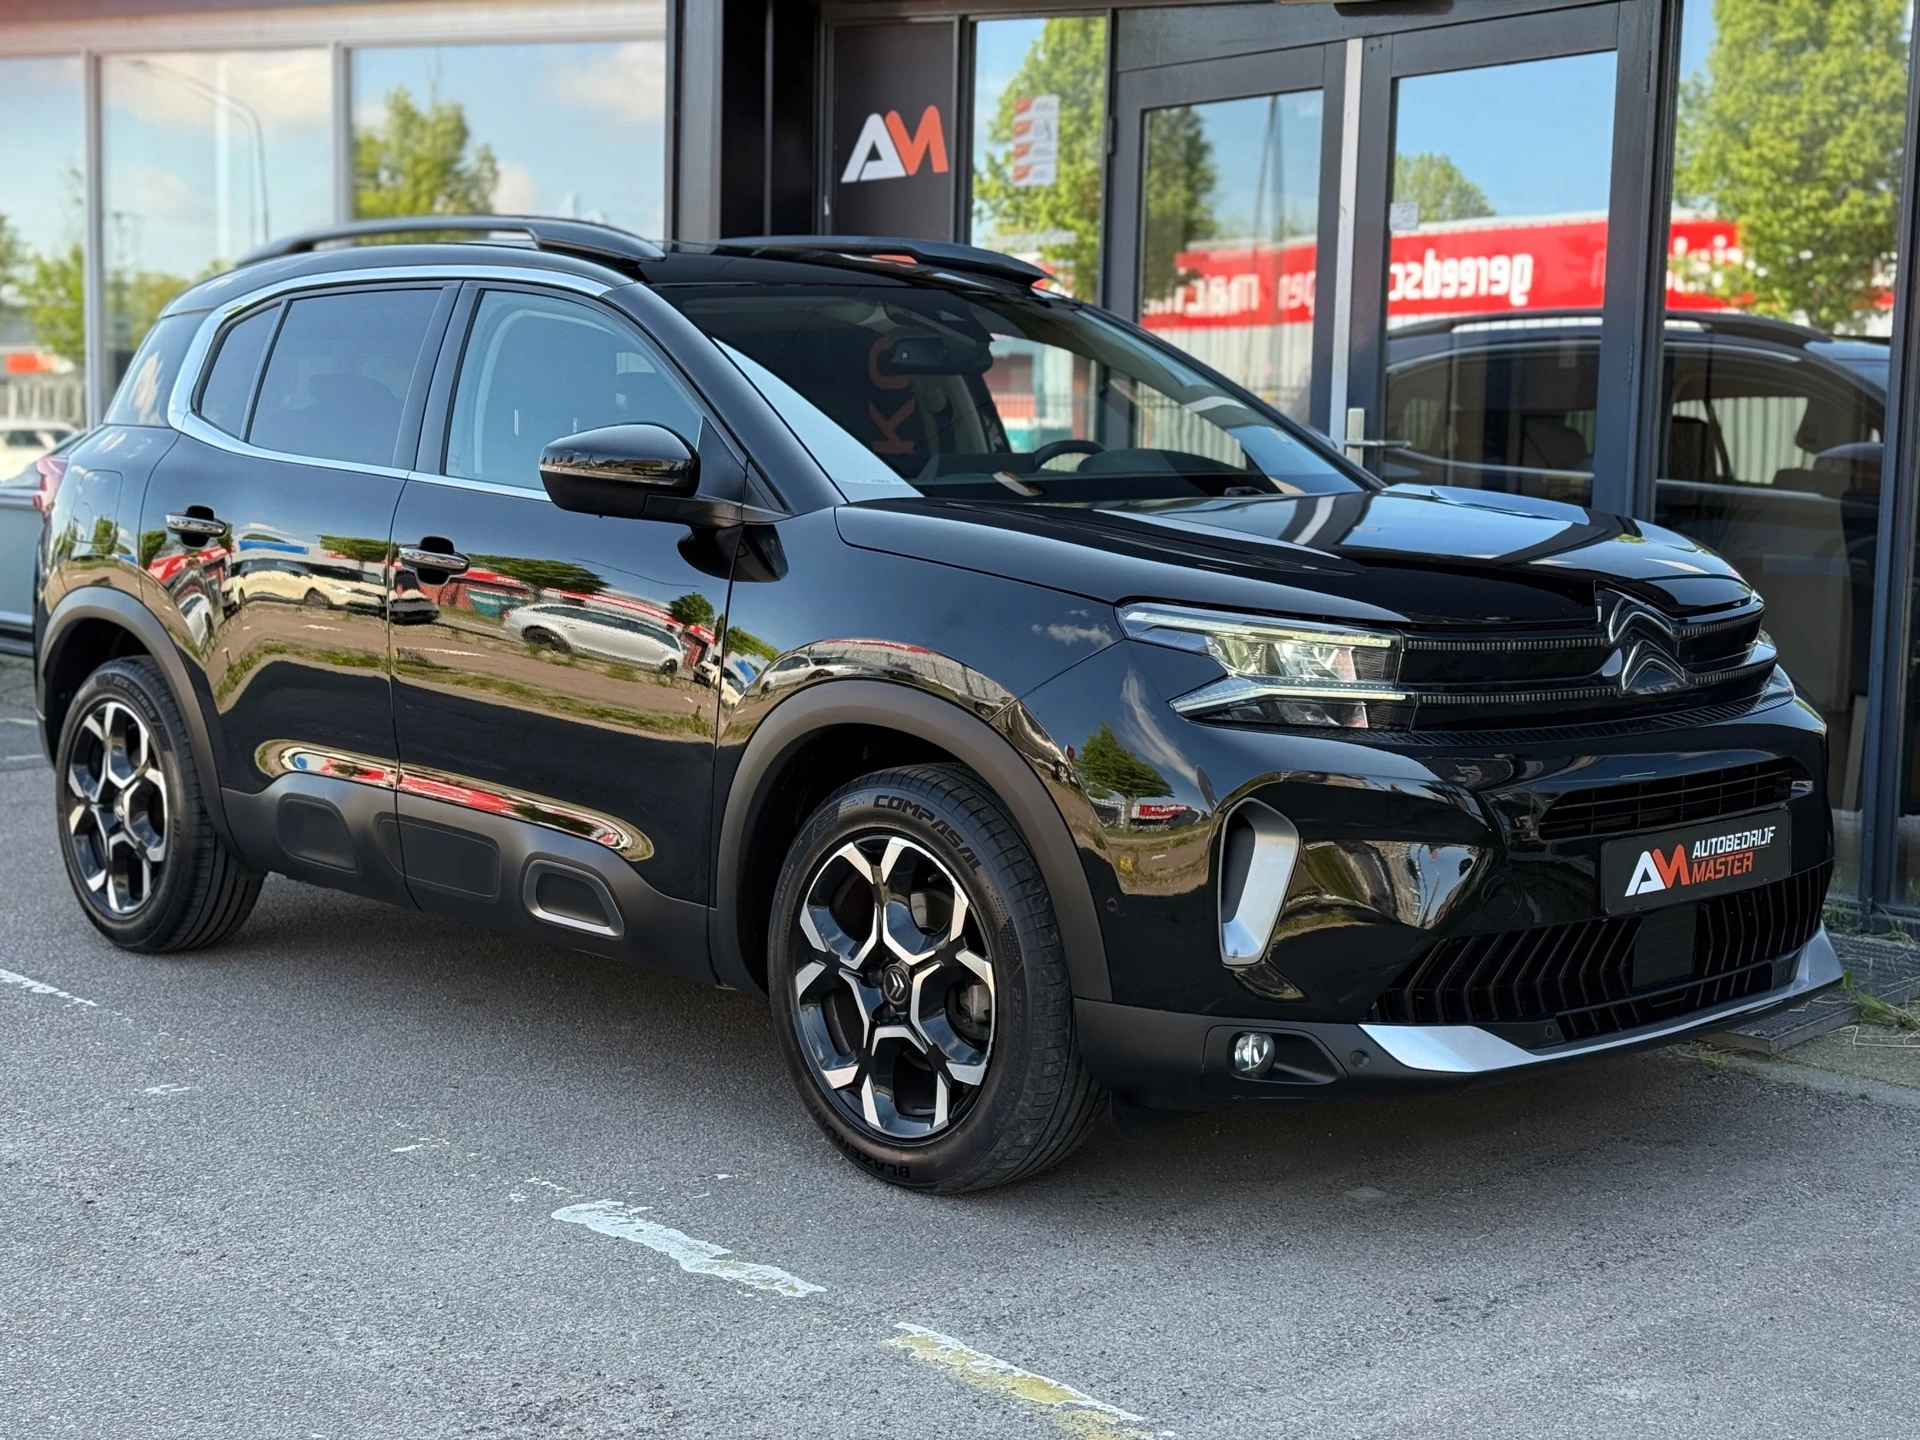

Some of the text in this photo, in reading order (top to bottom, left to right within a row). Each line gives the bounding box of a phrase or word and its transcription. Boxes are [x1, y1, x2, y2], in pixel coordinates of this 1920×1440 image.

[841, 104, 949, 184] AM
[873, 795, 982, 876] COMPASAL
[1692, 826, 1777, 859] AUTOBEDRIJF
[1624, 844, 1691, 897] AM
[1692, 852, 1754, 884] MASTER
